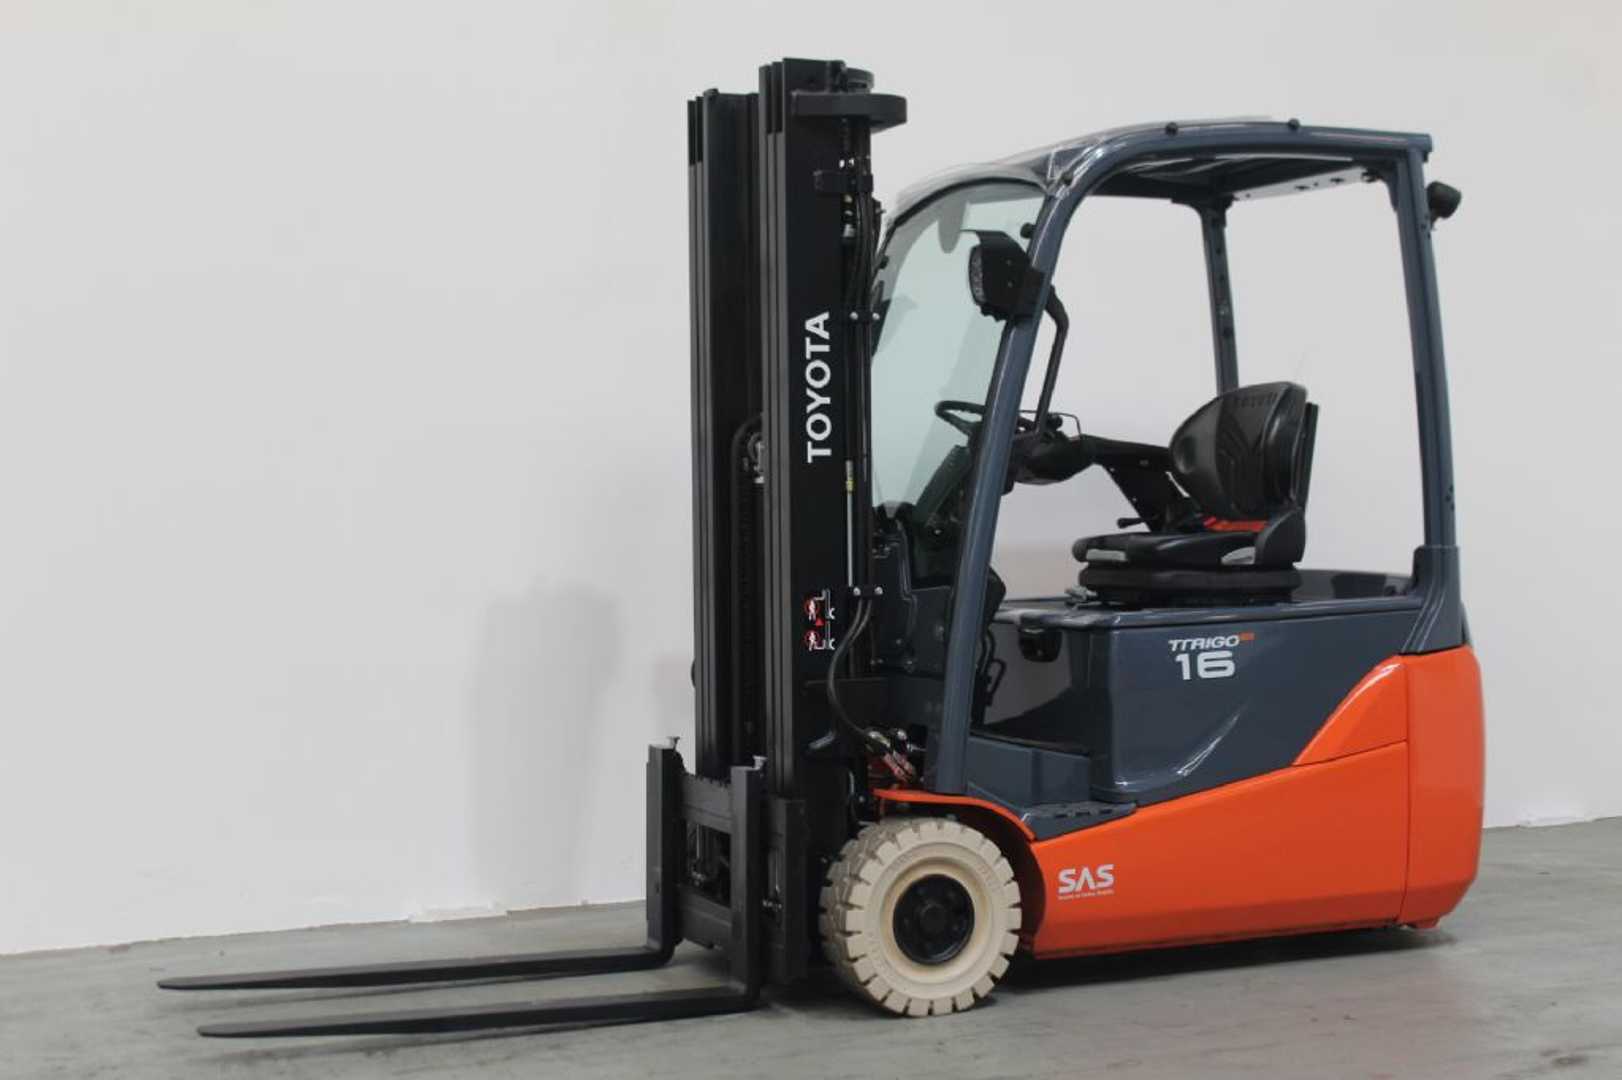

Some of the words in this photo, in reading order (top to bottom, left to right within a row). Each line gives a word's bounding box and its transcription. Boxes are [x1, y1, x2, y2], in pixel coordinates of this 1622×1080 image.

[805, 311, 832, 464] TOYOTA
[1175, 650, 1236, 680] 16
[1058, 864, 1115, 894] SAS
